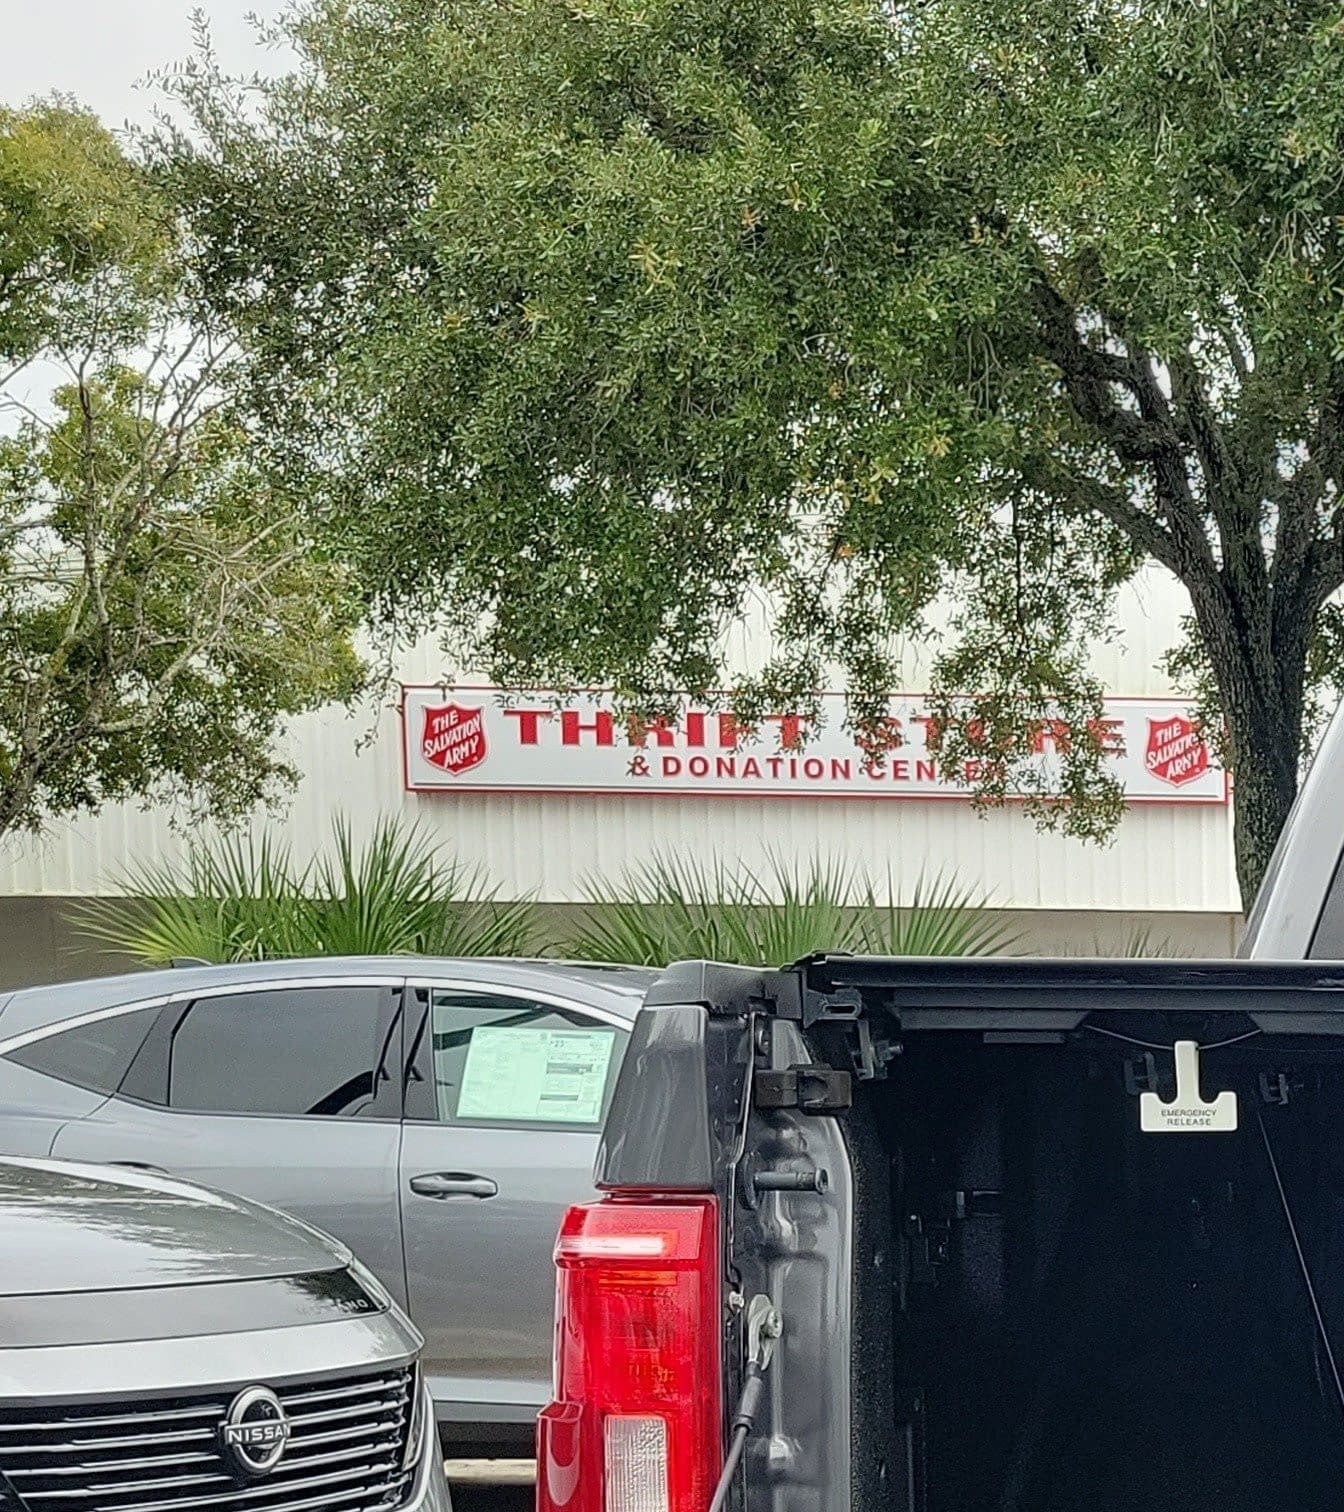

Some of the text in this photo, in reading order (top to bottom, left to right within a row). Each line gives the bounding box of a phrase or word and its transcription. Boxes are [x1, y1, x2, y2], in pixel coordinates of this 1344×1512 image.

[432, 709, 459, 734] THE
[1156, 722, 1182, 746] THE
[424, 713, 481, 758] SALVATION
[444, 734, 479, 769] ARMY
[1166, 747, 1202, 779] ARMY
[630, 755, 650, 777] &
[662, 755, 850, 780] DONATION
[1160, 1109, 1218, 1117] EMERGENCY
[1166, 1118, 1212, 1126] RELEASE
[228, 1423, 291, 1443] NISSAN
